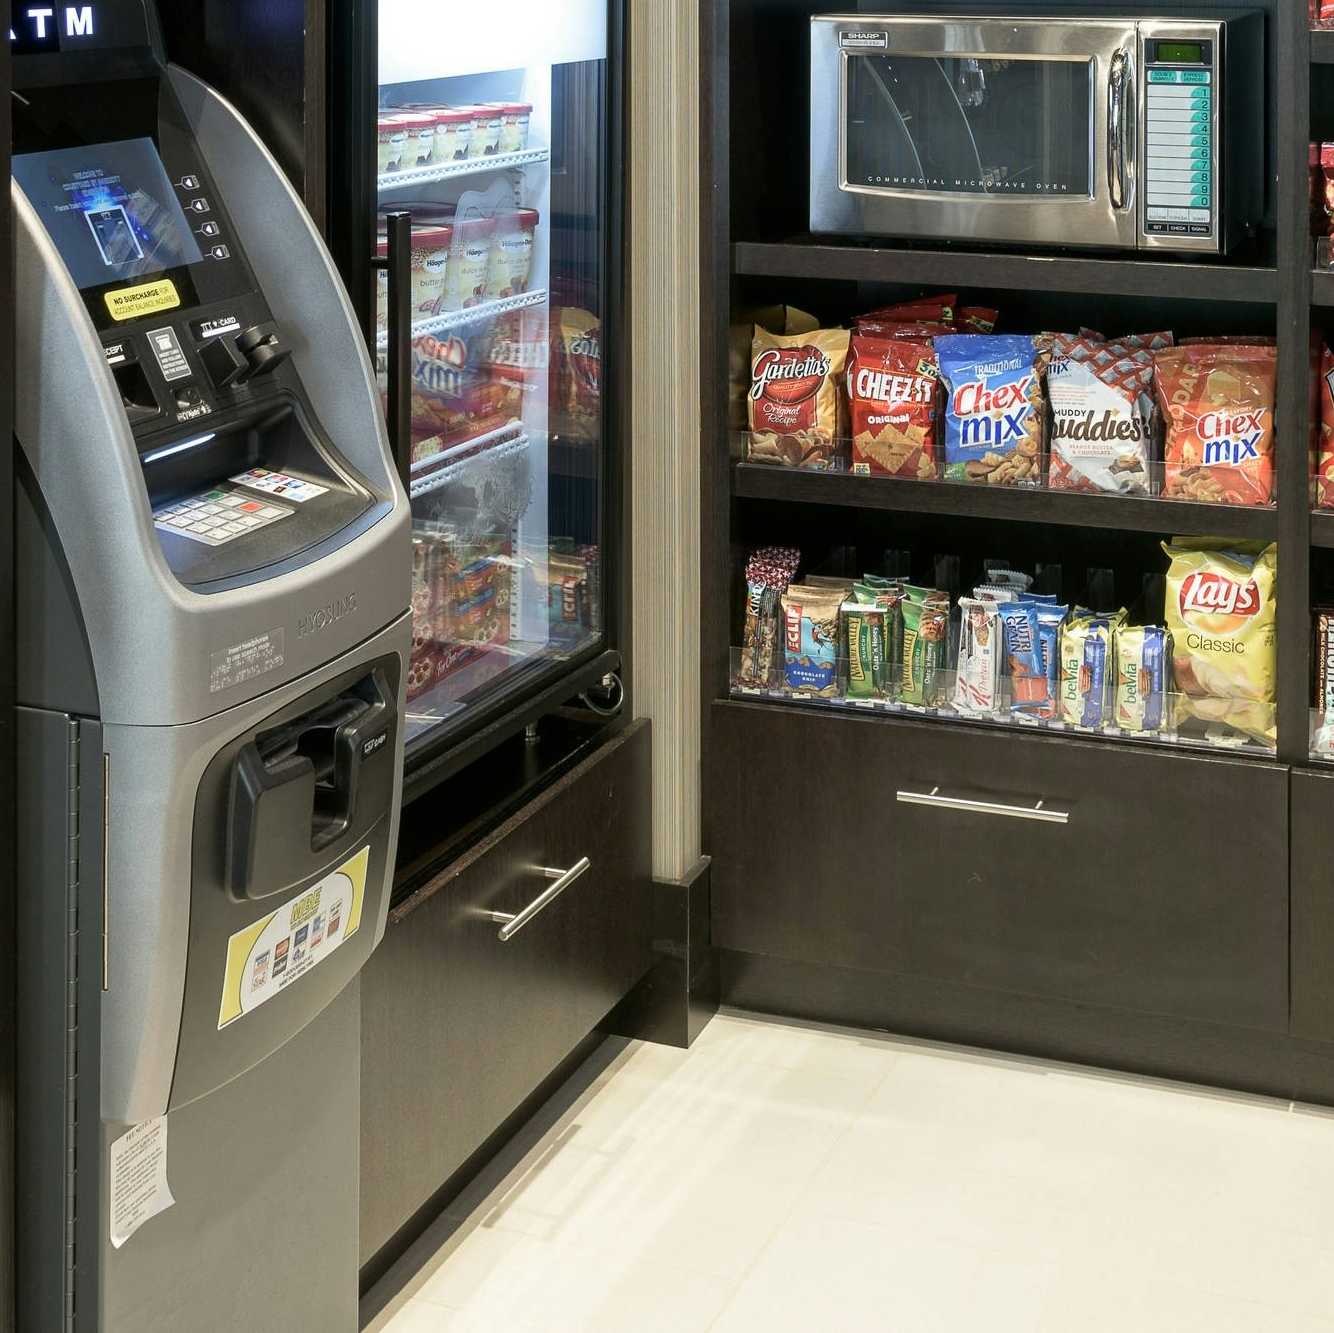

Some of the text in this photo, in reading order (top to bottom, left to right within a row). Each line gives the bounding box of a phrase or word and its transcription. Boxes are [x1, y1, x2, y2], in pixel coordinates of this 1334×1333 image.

[847, 32, 880, 40] SHARP
[868, 176, 945, 185] COMMERCIAL
[955, 180, 1026, 188] MICROWAVE
[113, 289, 159, 305] NO SURCHARGE
[753, 351, 831, 399] Gardetto's
[974, 358, 1023, 376] TRADITIONAL
[762, 403, 801, 416] Original
[953, 375, 1034, 415] Chex
[767, 414, 798, 426] Recipe
[962, 406, 1027, 447] mix
[1055, 409, 1086, 417] MUDDY
[1197, 408, 1267, 439] Chex
[1205, 433, 1261, 466] mix
[749, 580, 766, 616] KIND
[1183, 573, 1261, 614] Lay's
[297, 592, 358, 640] HYOSUNG
[786, 605, 802, 642] CLIF
[872, 626, 880, 671] Oats Honey
[924, 641, 933, 663] Honey
[1186, 633, 1245, 654] Classic
[793, 670, 826, 679] CHOCOLATE
[979, 658, 988, 694] Protein
[1064, 658, 1080, 701] belVita
[1123, 662, 1137, 704] belVita
